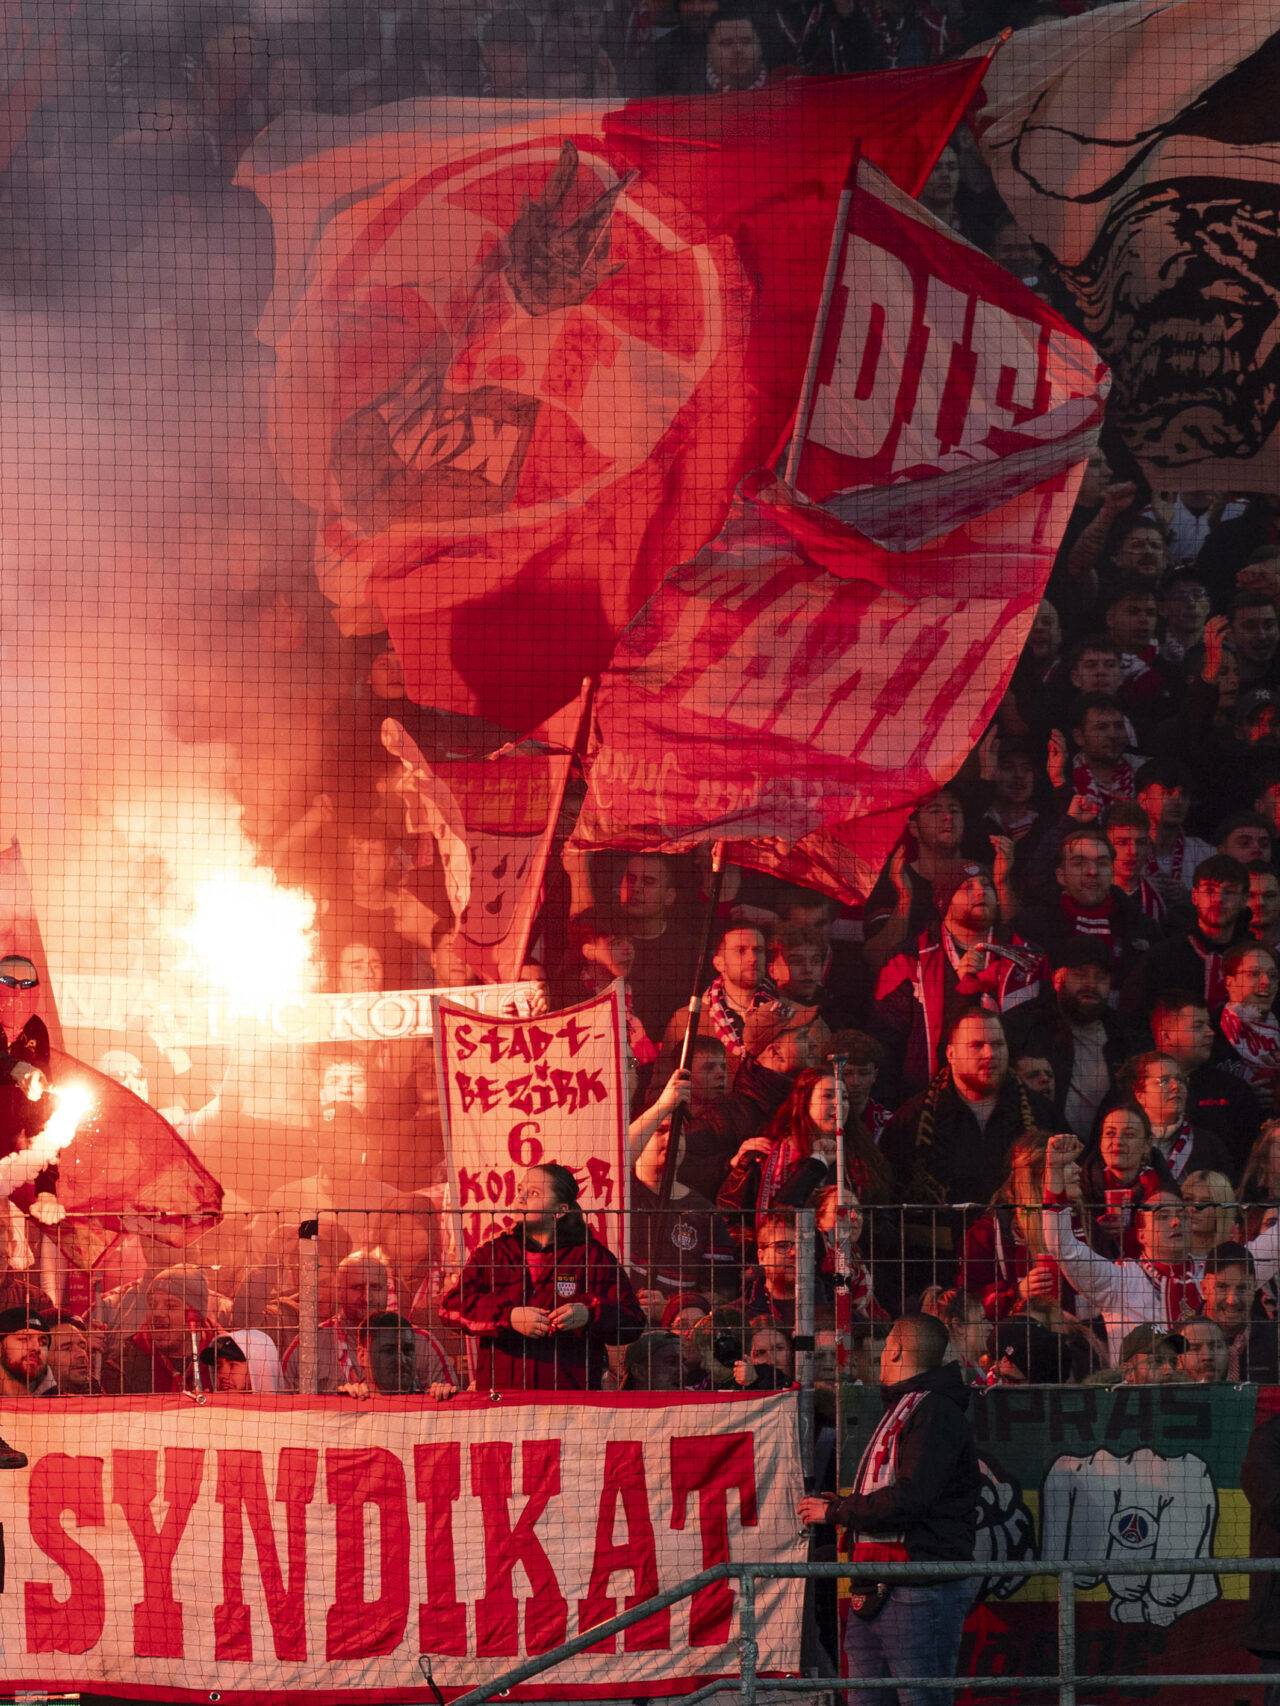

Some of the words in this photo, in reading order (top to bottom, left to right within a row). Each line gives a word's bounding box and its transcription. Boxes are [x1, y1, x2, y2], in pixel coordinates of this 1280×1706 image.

[454, 1060, 608, 1115] BEZIRK
[507, 1121, 544, 1167] 6
[23, 1430, 759, 1662] SYNDIKAT
